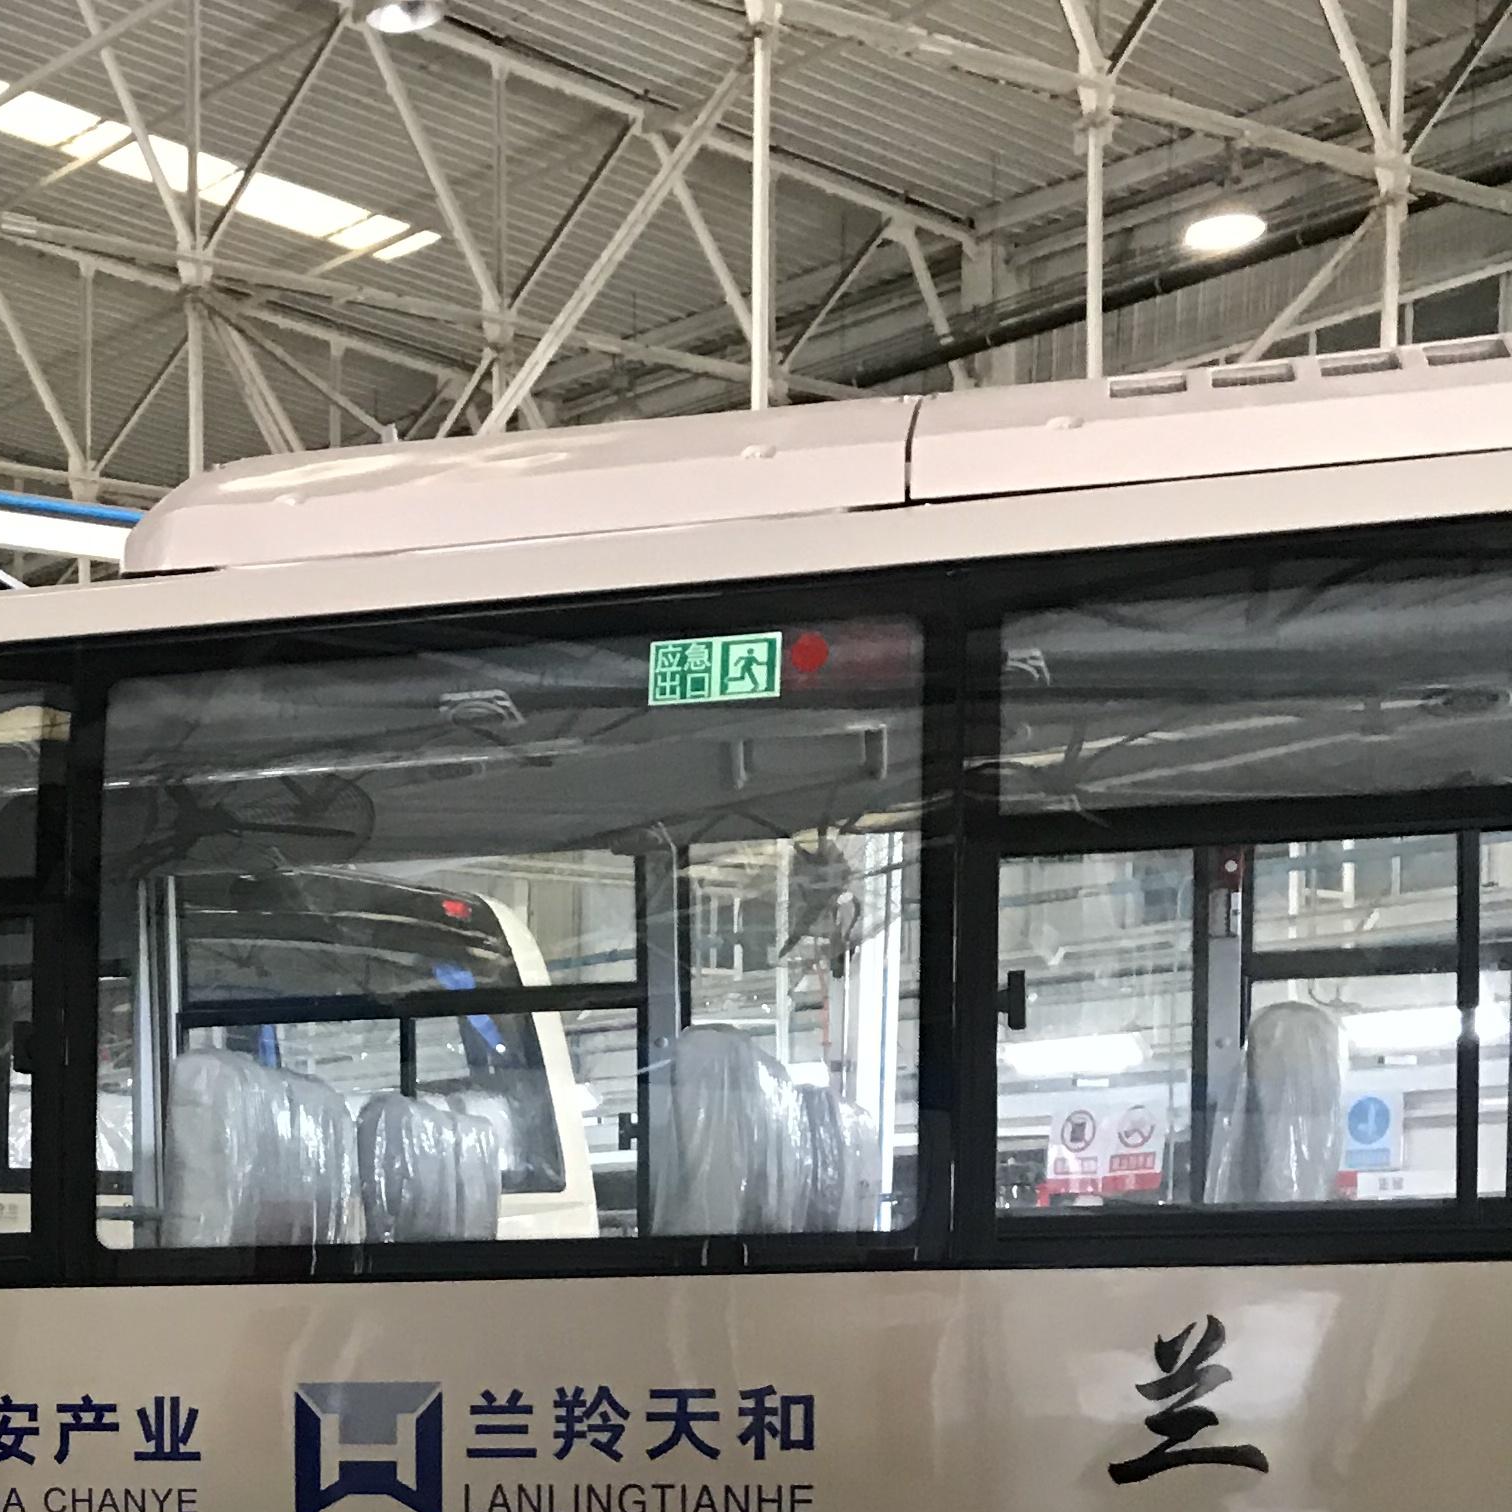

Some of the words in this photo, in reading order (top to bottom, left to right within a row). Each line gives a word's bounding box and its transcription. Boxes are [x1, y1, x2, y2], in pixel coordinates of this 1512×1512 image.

[655, 643, 712, 673] 应急
[655, 672, 710, 701] 出口
[465, 1384, 816, 1463] 兰羚天和
[1107, 1314, 1269, 1486] 兰
